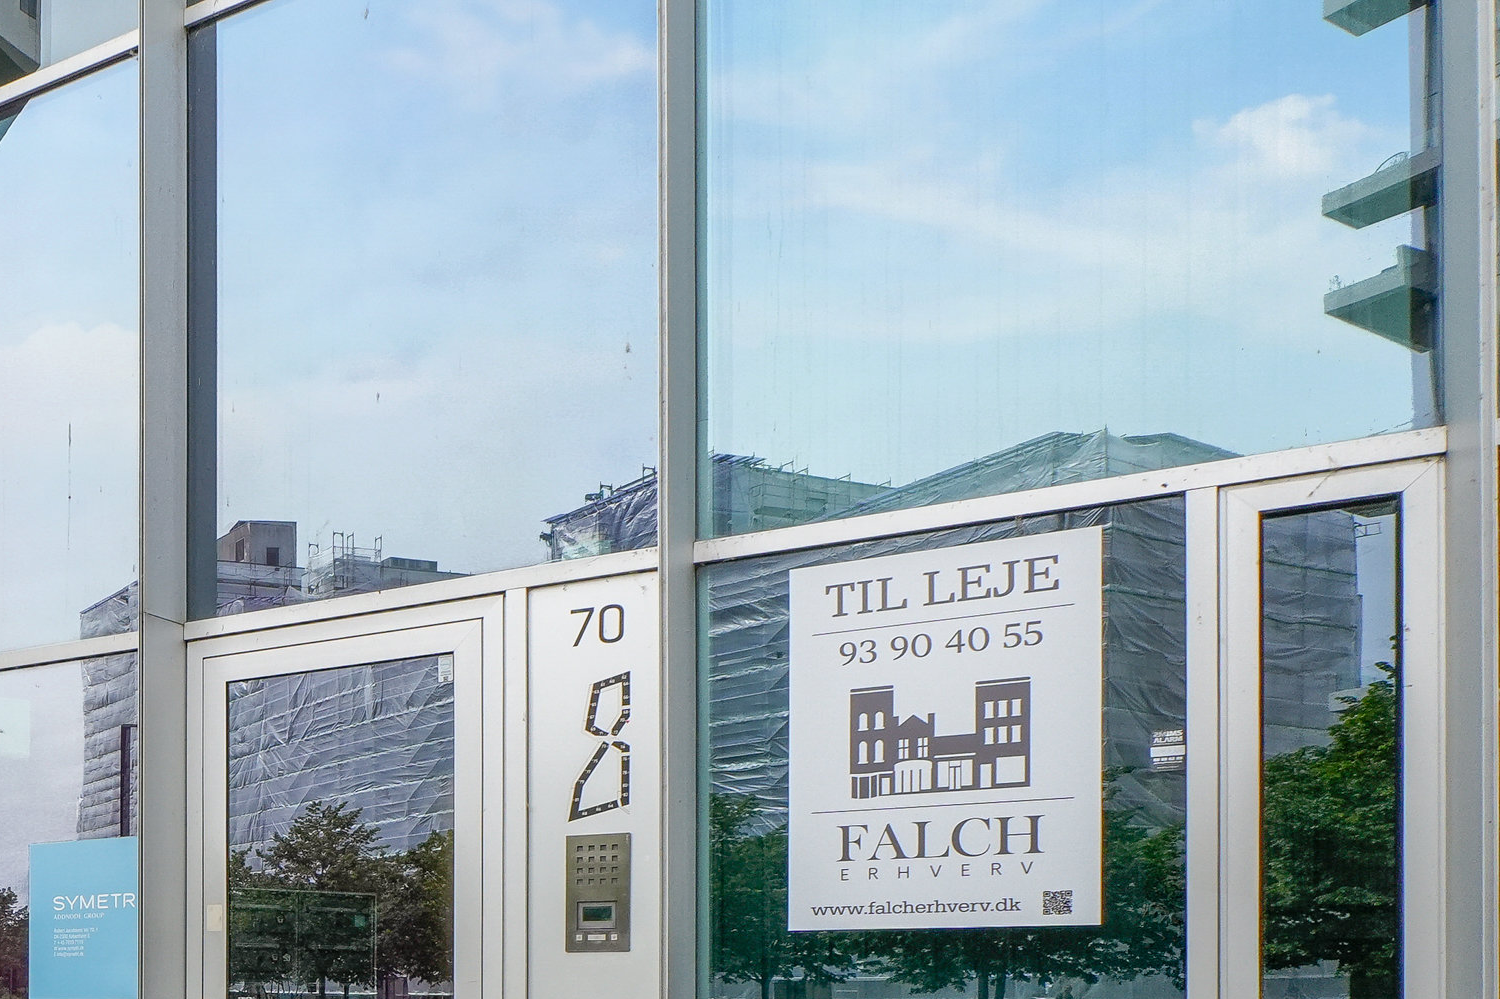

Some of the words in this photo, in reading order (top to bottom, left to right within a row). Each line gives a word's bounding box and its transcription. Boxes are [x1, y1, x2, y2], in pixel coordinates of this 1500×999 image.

[824, 576, 908, 618] TIL
[922, 554, 1060, 606] LEJE
[570, 604, 625, 647] 70
[839, 639, 878, 666] 93
[890, 633, 933, 661] 90
[945, 626, 990, 654] 40
[1003, 620, 1044, 649] 55
[836, 814, 1046, 862] FALCH
[840, 861, 1034, 881] ERHVERV
[53, 892, 137, 911] SYMETR
[811, 898, 1022, 916] www.falcherhverv.dk
